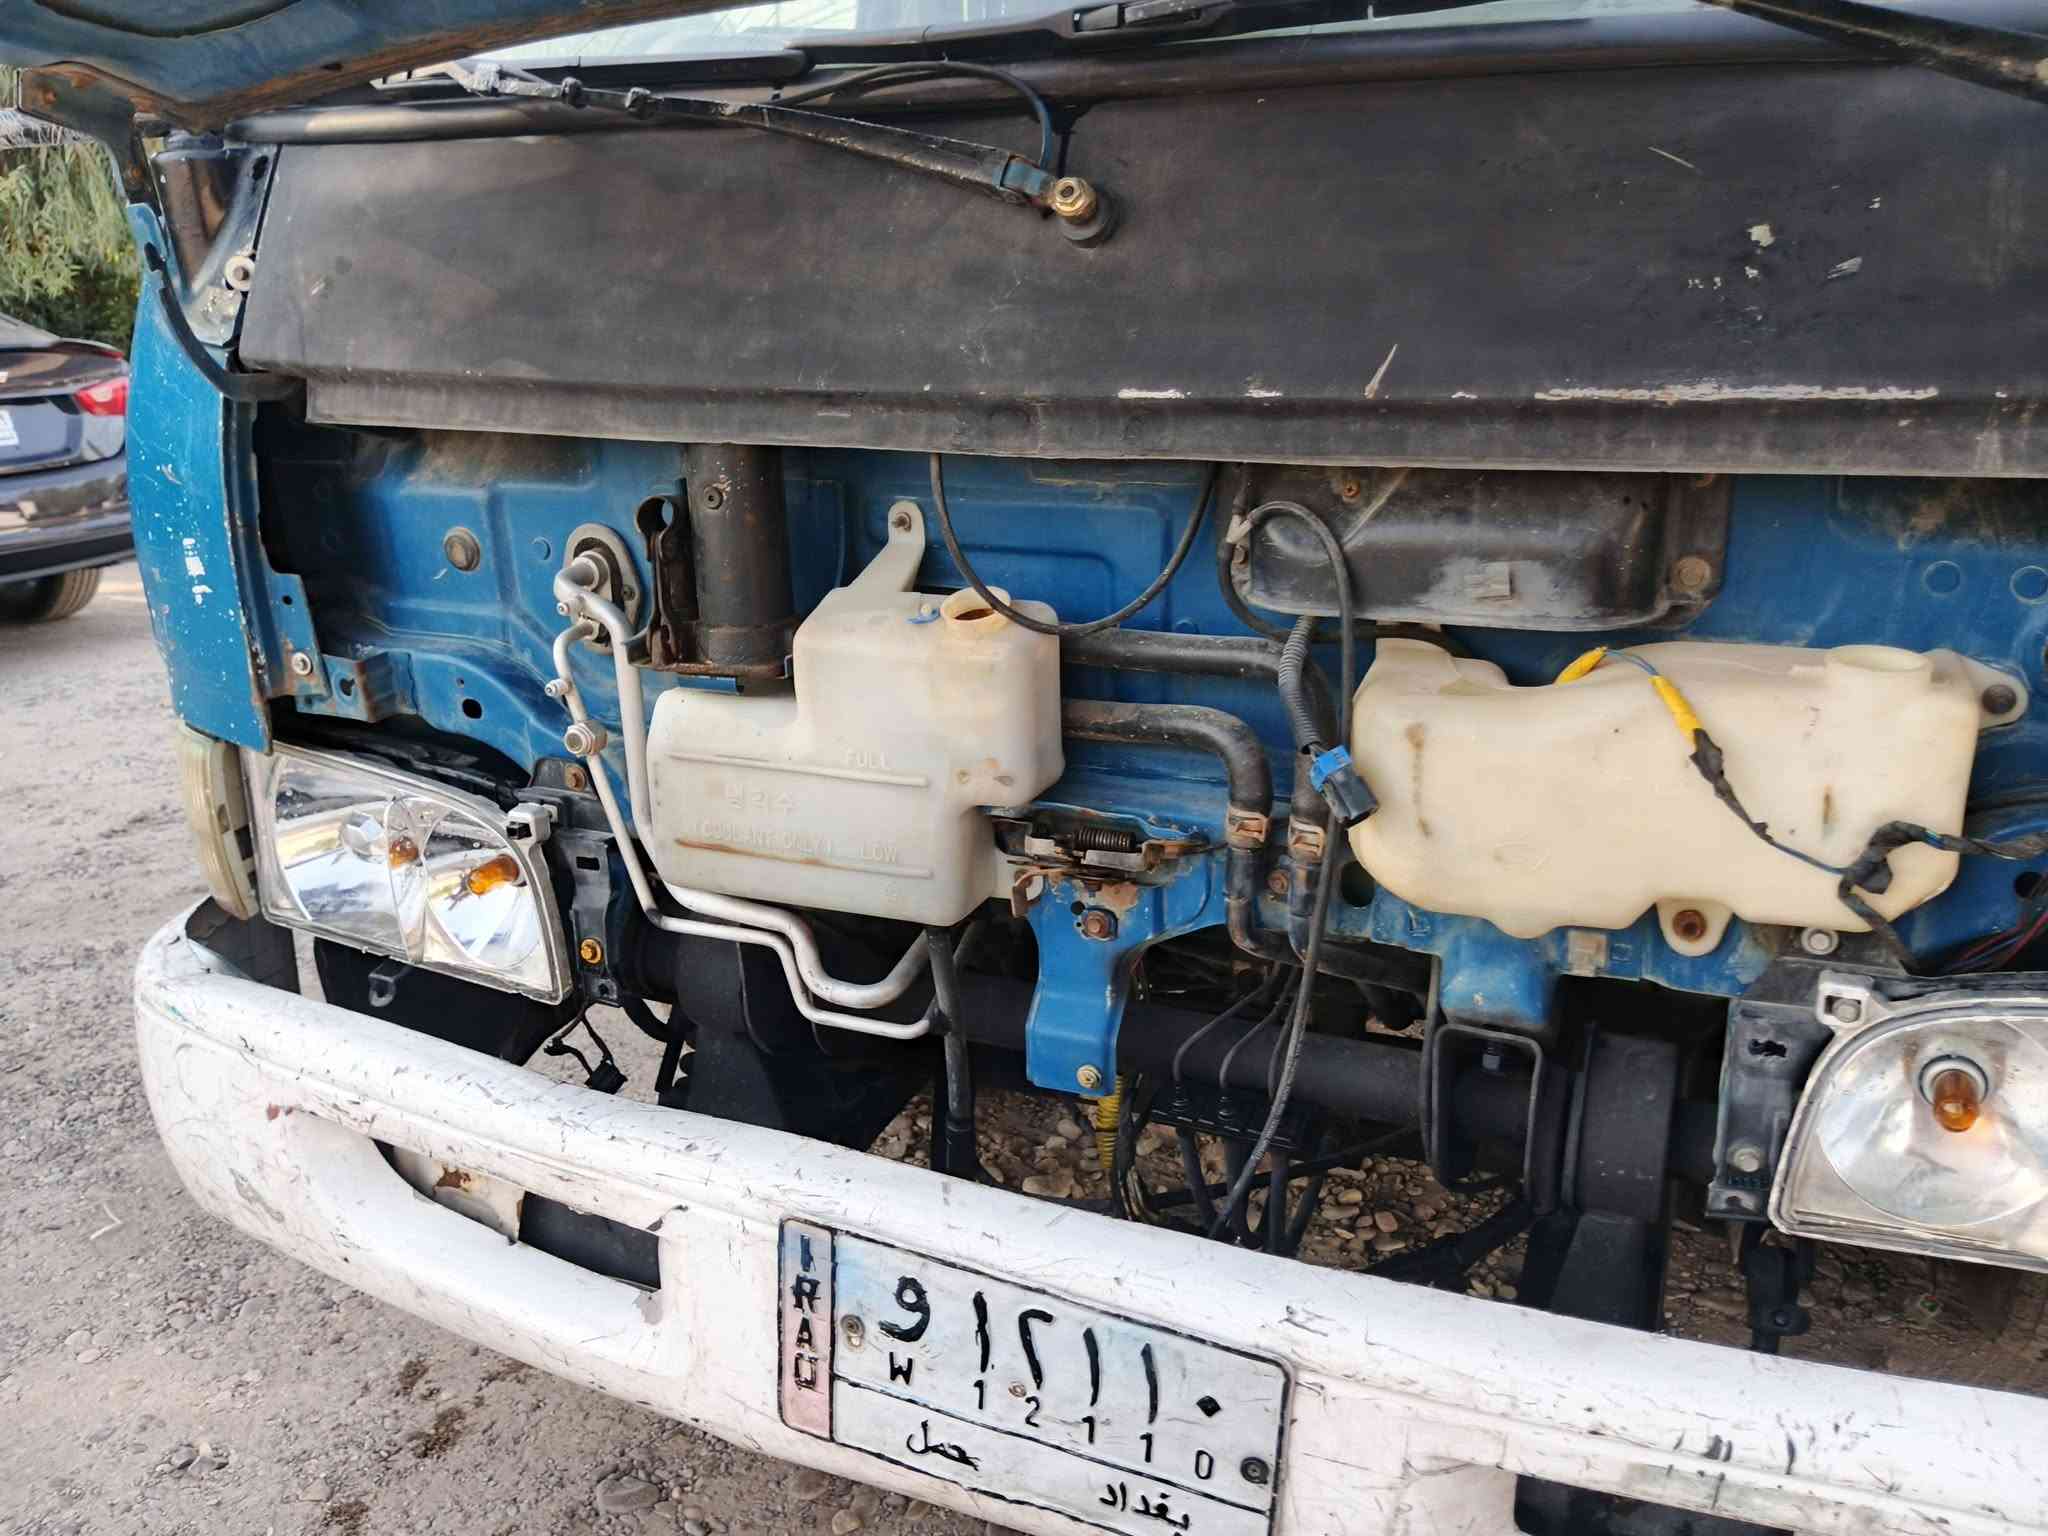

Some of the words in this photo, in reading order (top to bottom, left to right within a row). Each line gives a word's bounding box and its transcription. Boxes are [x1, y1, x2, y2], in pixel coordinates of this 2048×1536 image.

[842, 748, 893, 770] FULL
[861, 840, 898, 864] LOW
[791, 1234, 821, 1390] IRAQ
[889, 1351, 914, 1386] W
[1099, 1481, 1191, 1536] بغداد
